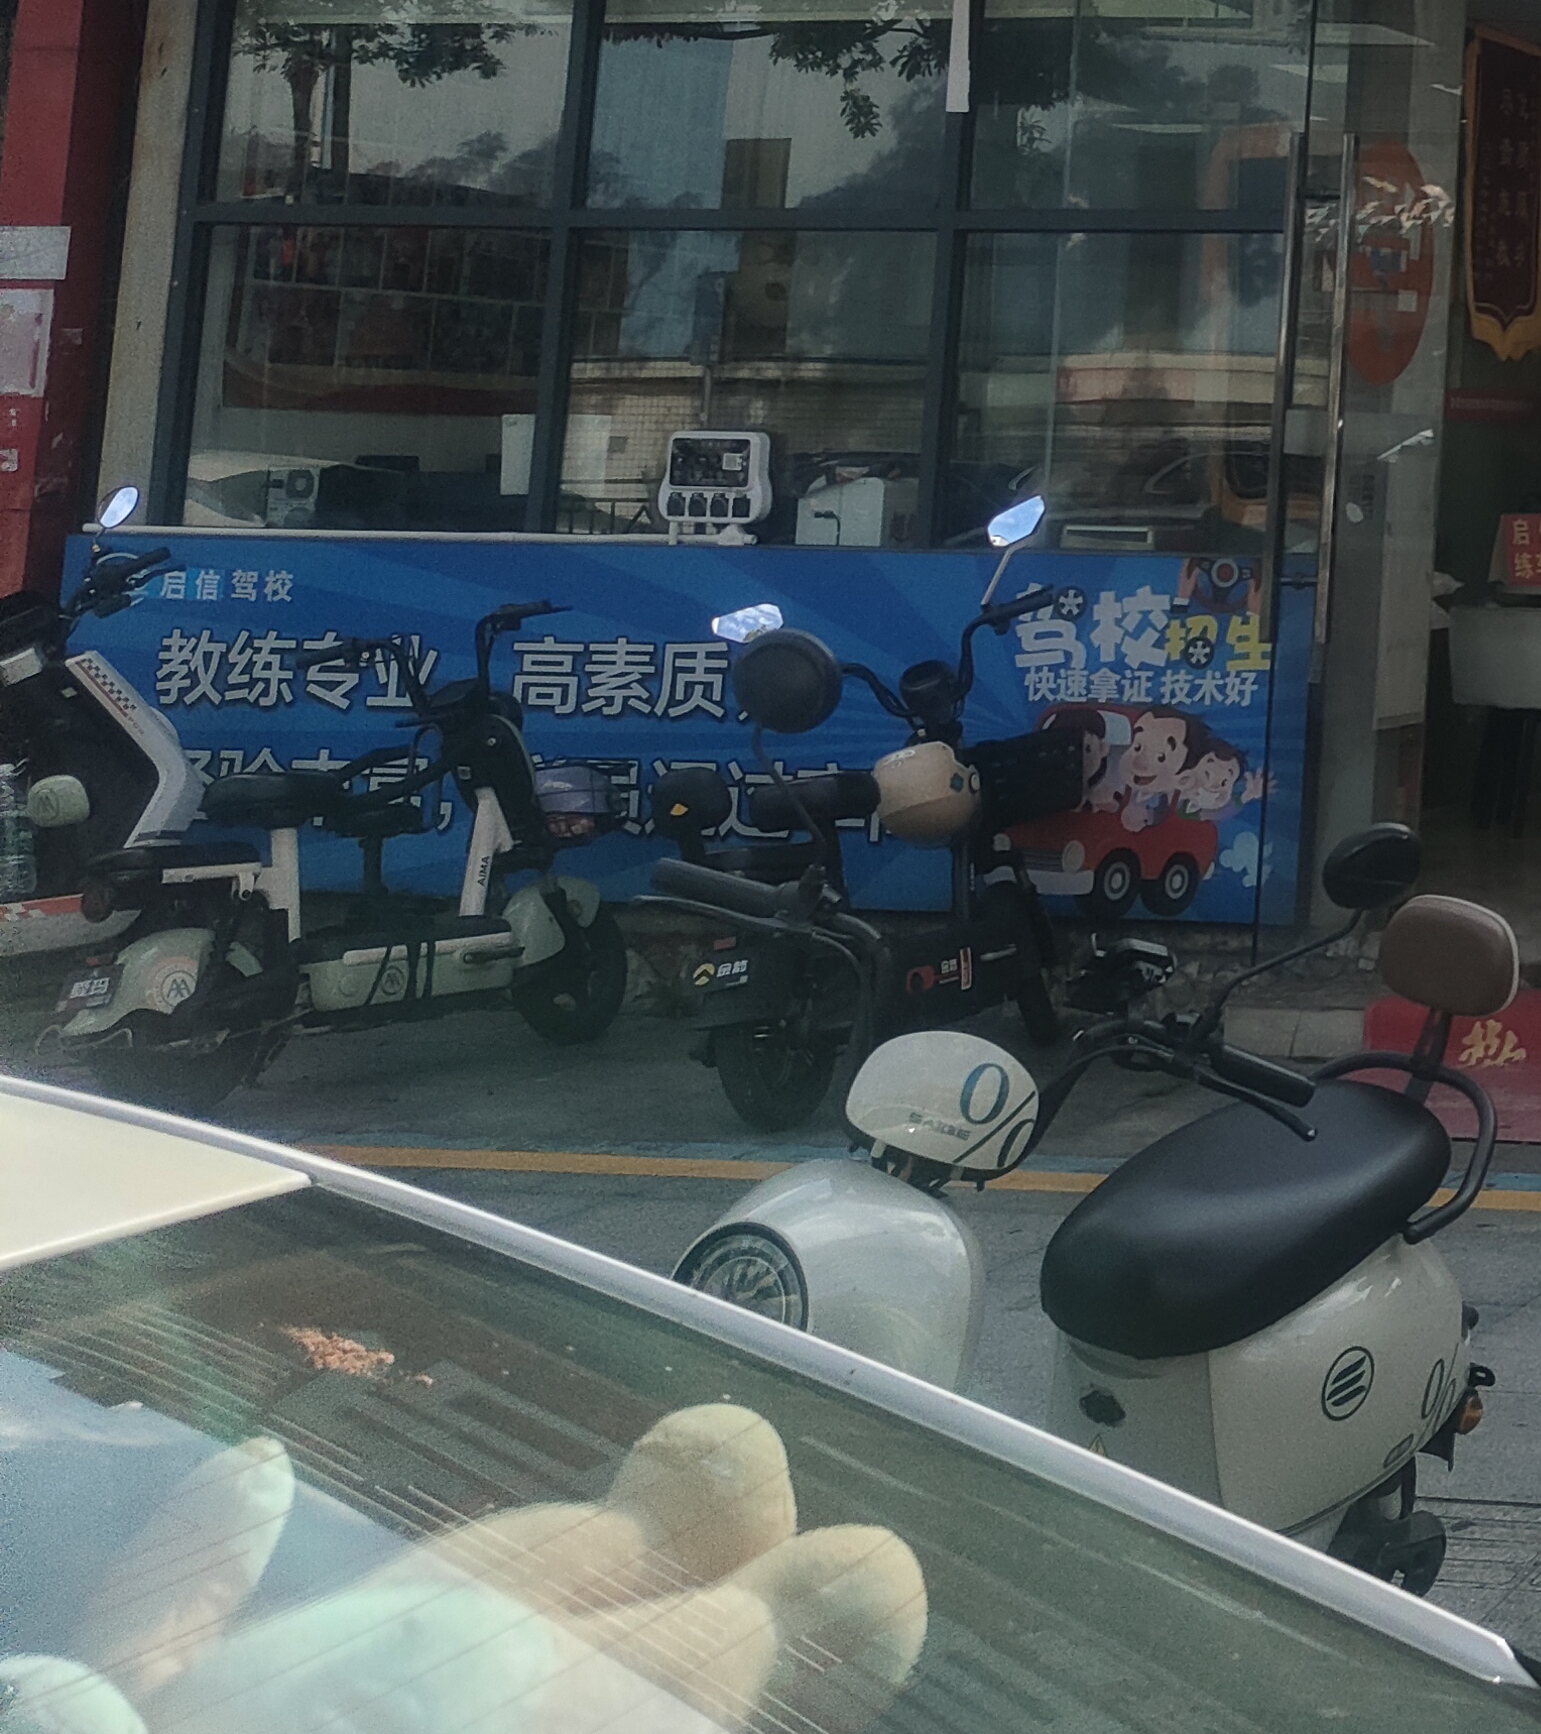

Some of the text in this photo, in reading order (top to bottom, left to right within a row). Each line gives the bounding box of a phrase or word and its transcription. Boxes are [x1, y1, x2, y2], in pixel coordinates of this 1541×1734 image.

[160, 569, 295, 603] 启信驾校
[155, 628, 438, 710] 教练专业
[1024, 667, 1259, 708] 快速拿证 技术好
